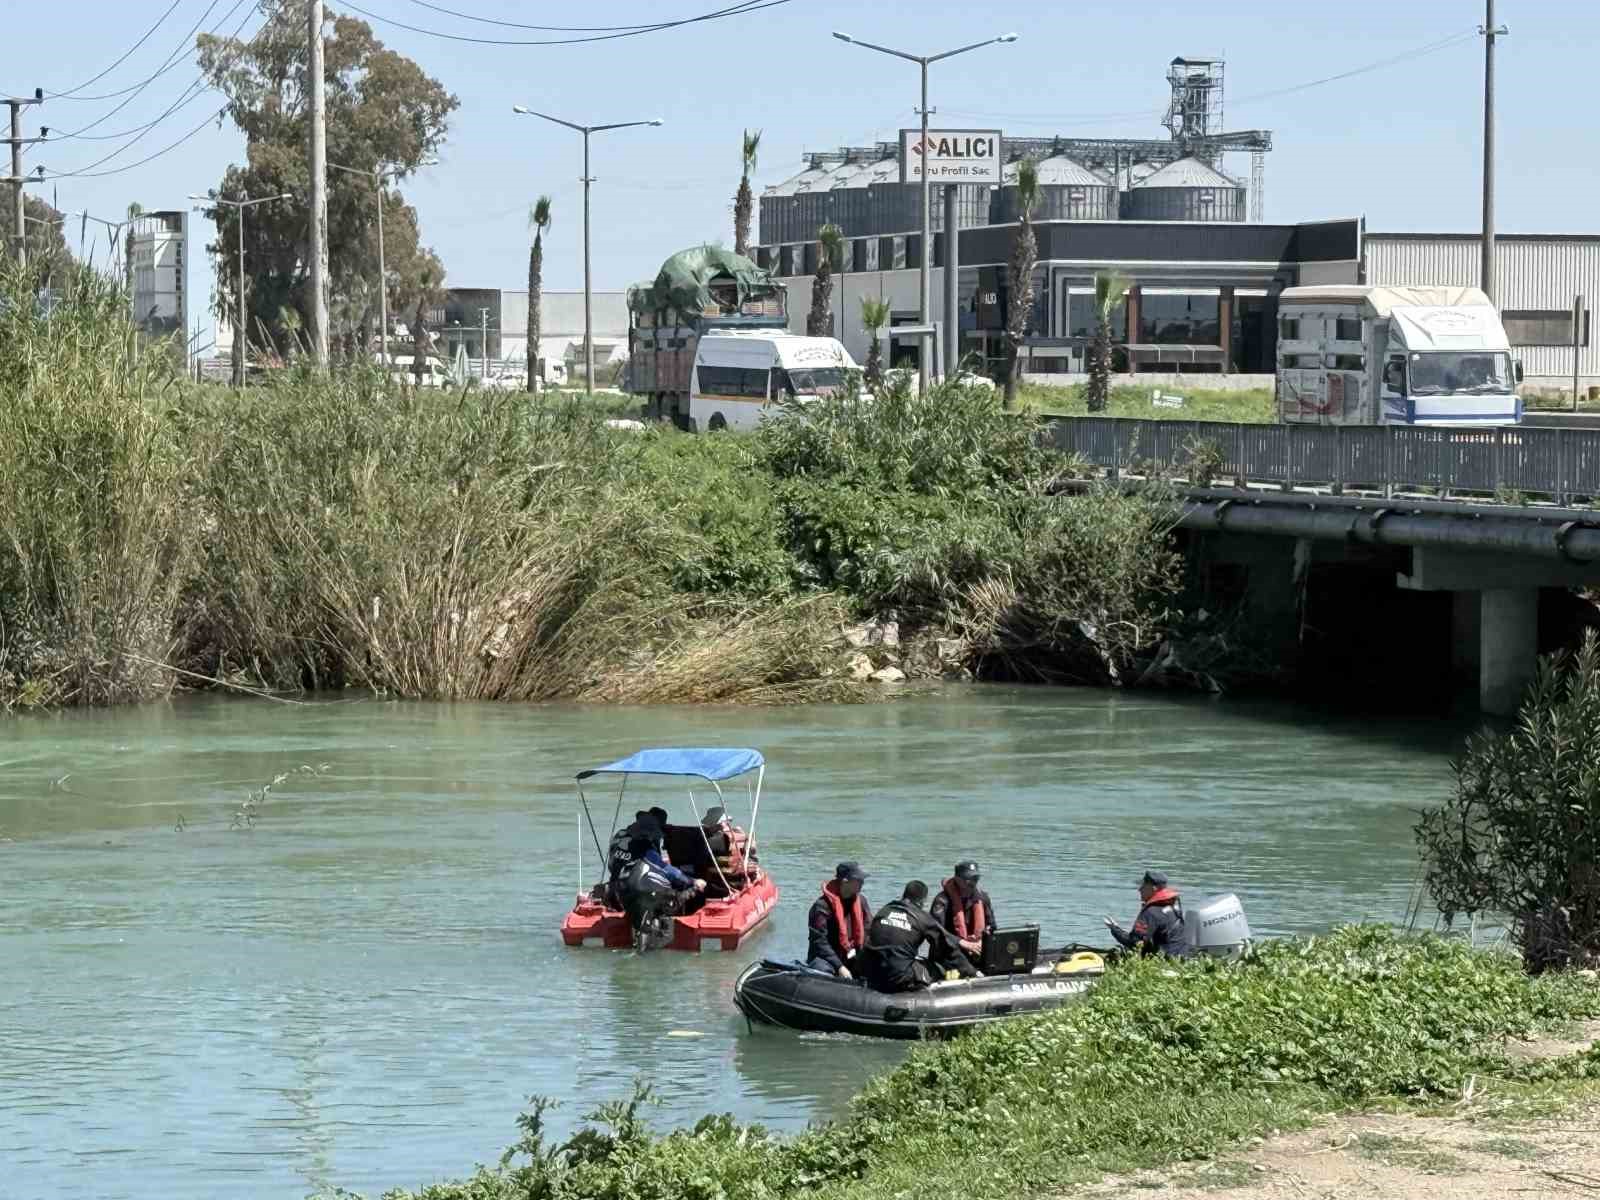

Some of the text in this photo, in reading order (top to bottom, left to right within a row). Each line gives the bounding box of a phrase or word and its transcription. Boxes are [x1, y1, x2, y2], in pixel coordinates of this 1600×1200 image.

[937, 137, 994, 158] ALICI
[914, 165, 991, 175] Bru Profil Sac
[1201, 911, 1242, 928] HONDA
